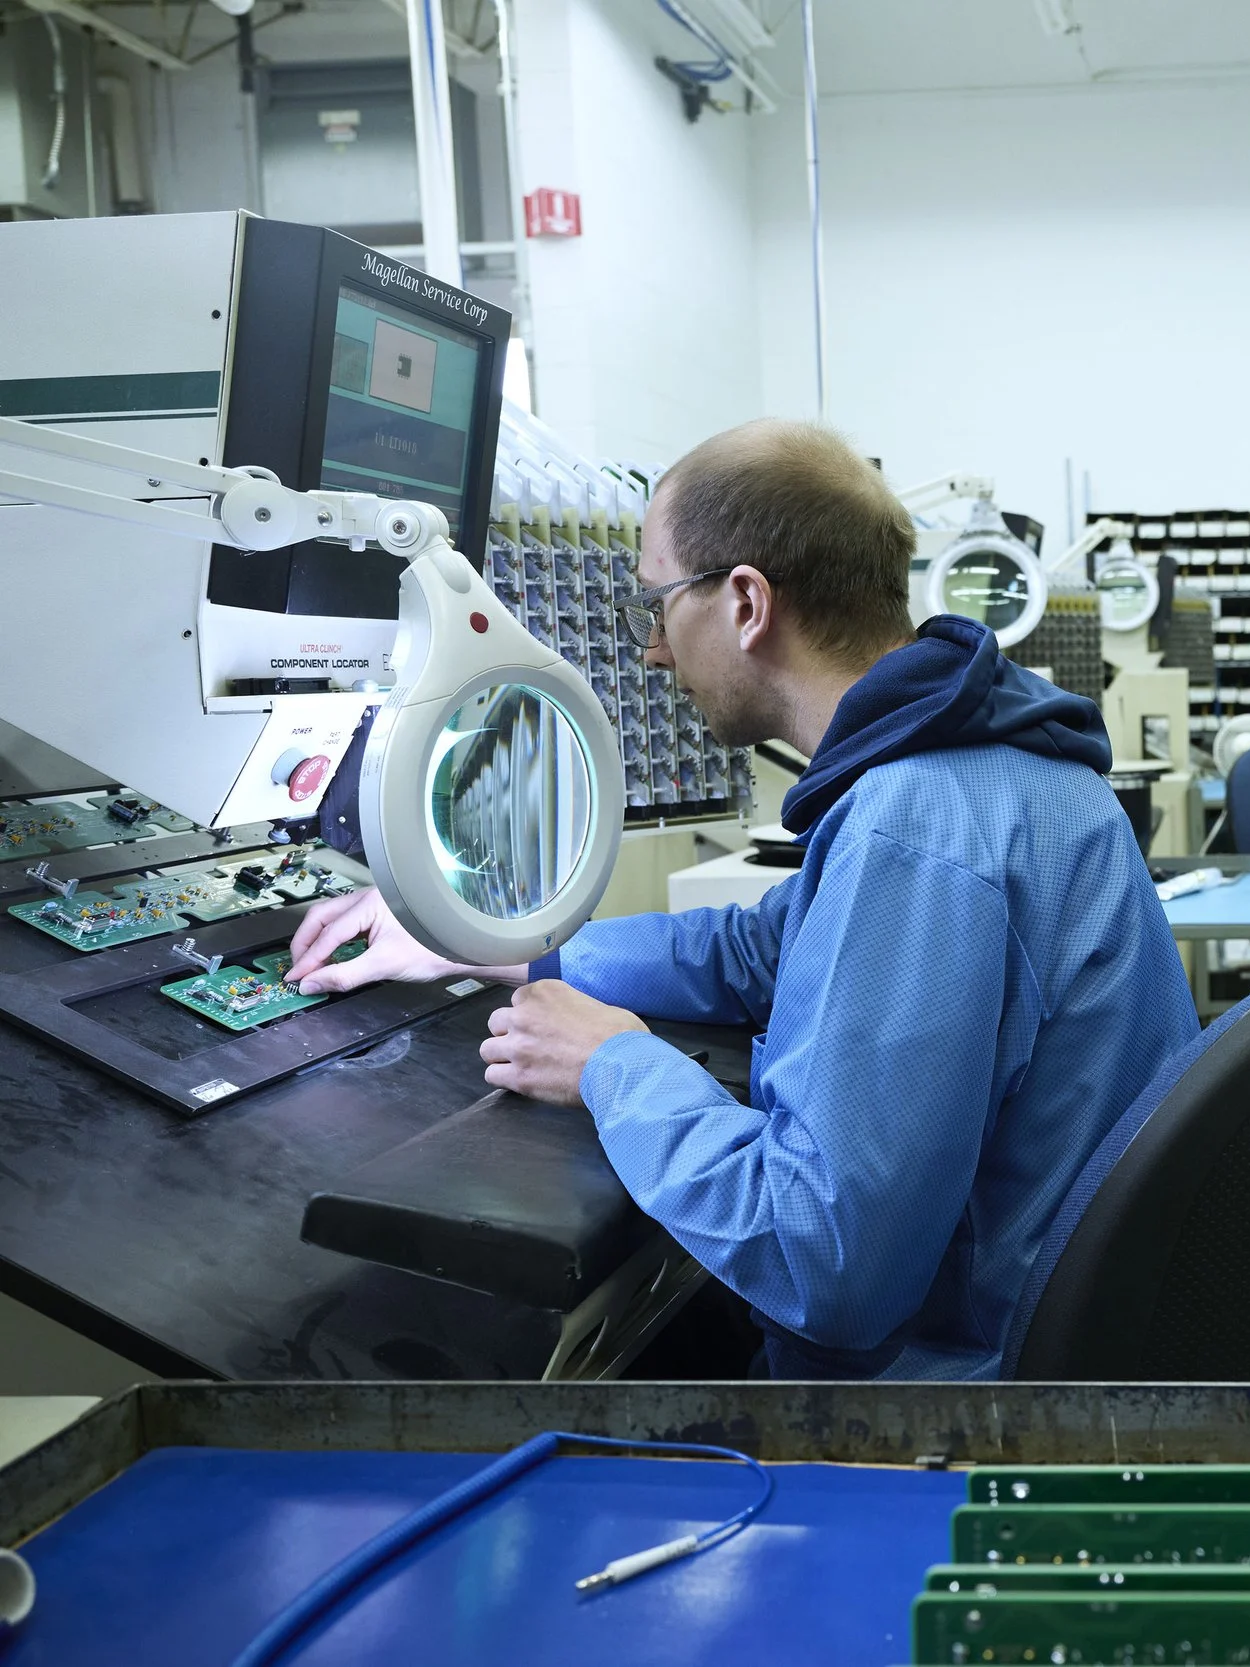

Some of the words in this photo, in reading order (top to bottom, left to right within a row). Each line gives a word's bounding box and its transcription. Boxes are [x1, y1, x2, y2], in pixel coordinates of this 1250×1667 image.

[361, 253, 419, 293] Magellan
[421, 279, 461, 310] Service
[463, 297, 488, 326] Corp
[299, 643, 319, 653] ULTRA
[319, 643, 342, 653] CLINCH
[270, 659, 328, 669] COMPONENT
[331, 659, 370, 668] LOCATOR
[291, 727, 313, 735] POWER
[297, 760, 322, 784] STOP
